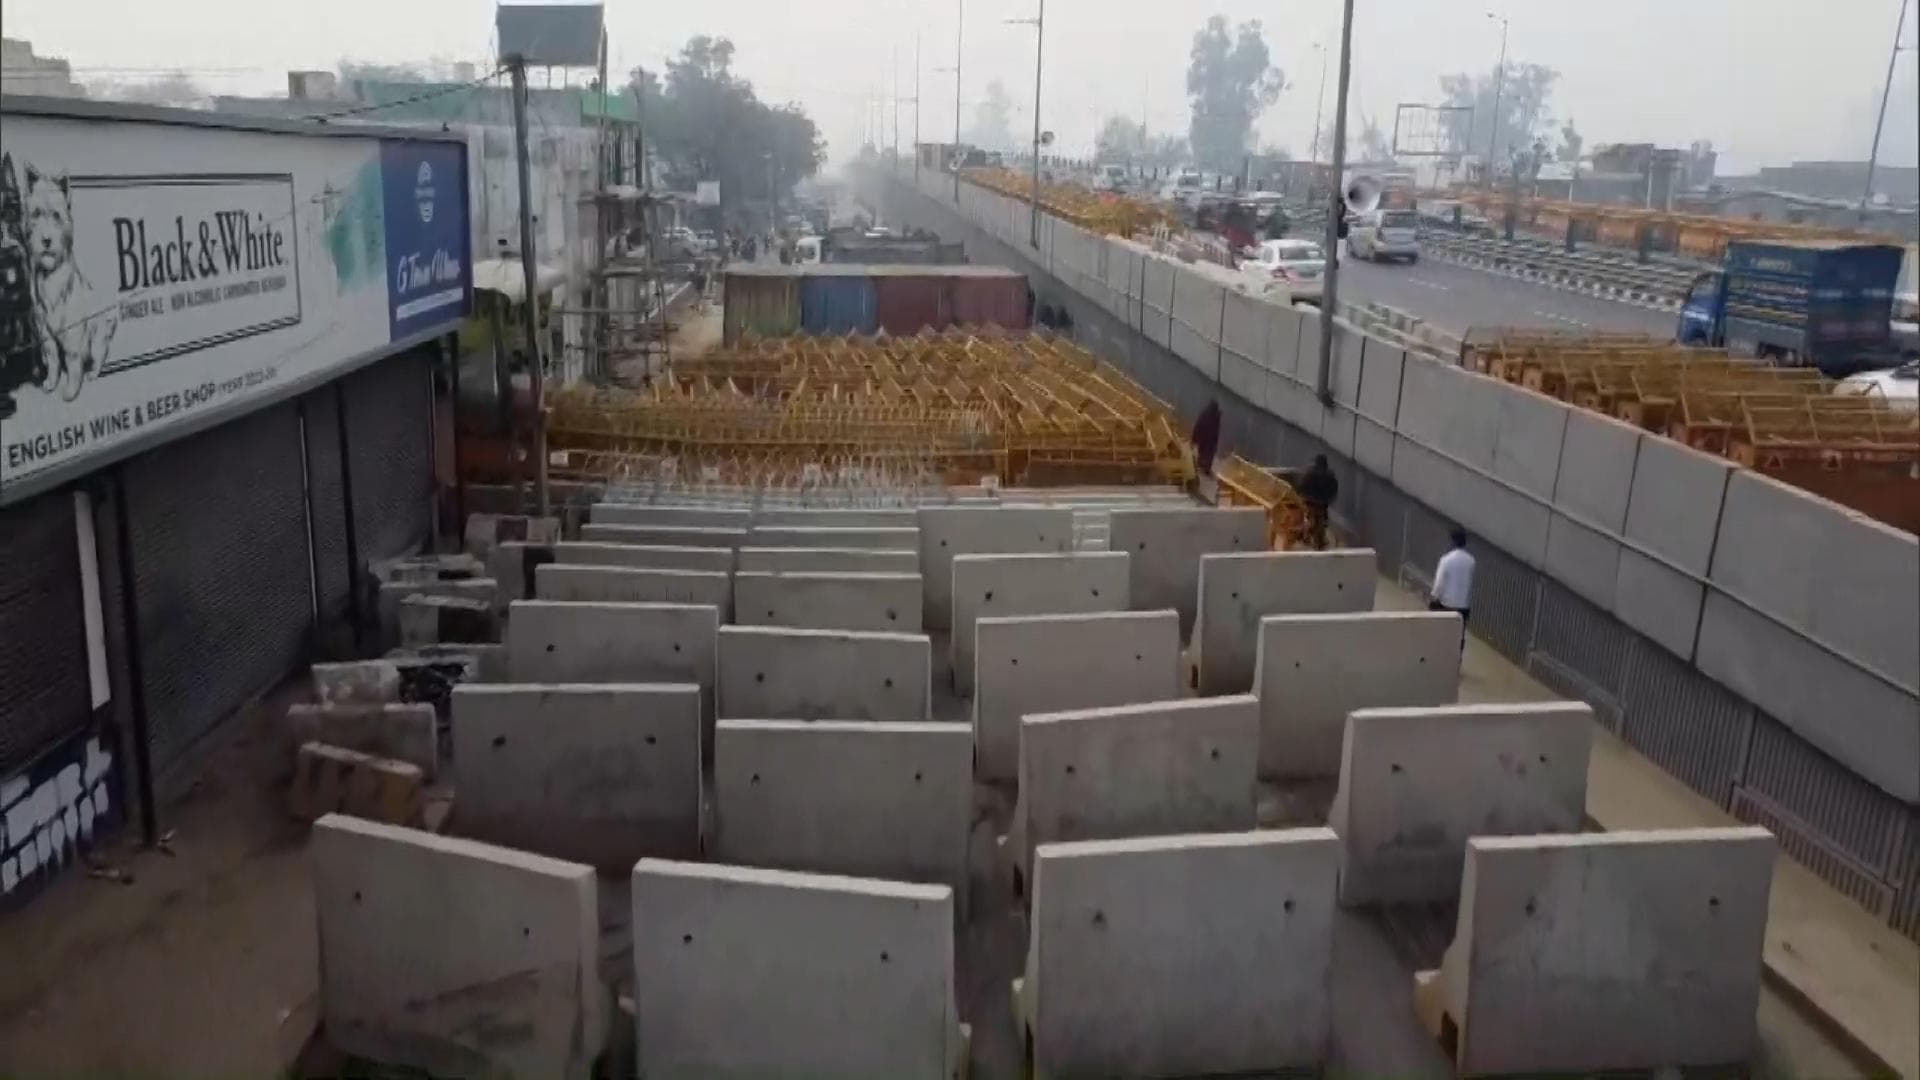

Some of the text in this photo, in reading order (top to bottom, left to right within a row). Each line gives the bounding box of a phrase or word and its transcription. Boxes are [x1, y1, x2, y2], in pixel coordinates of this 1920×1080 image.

[8, 424, 85, 468] ENGLISH
[90, 408, 131, 439] WINE
[134, 405, 143, 427] &
[147, 393, 181, 420] BEER
[184, 381, 216, 407] SHOP
